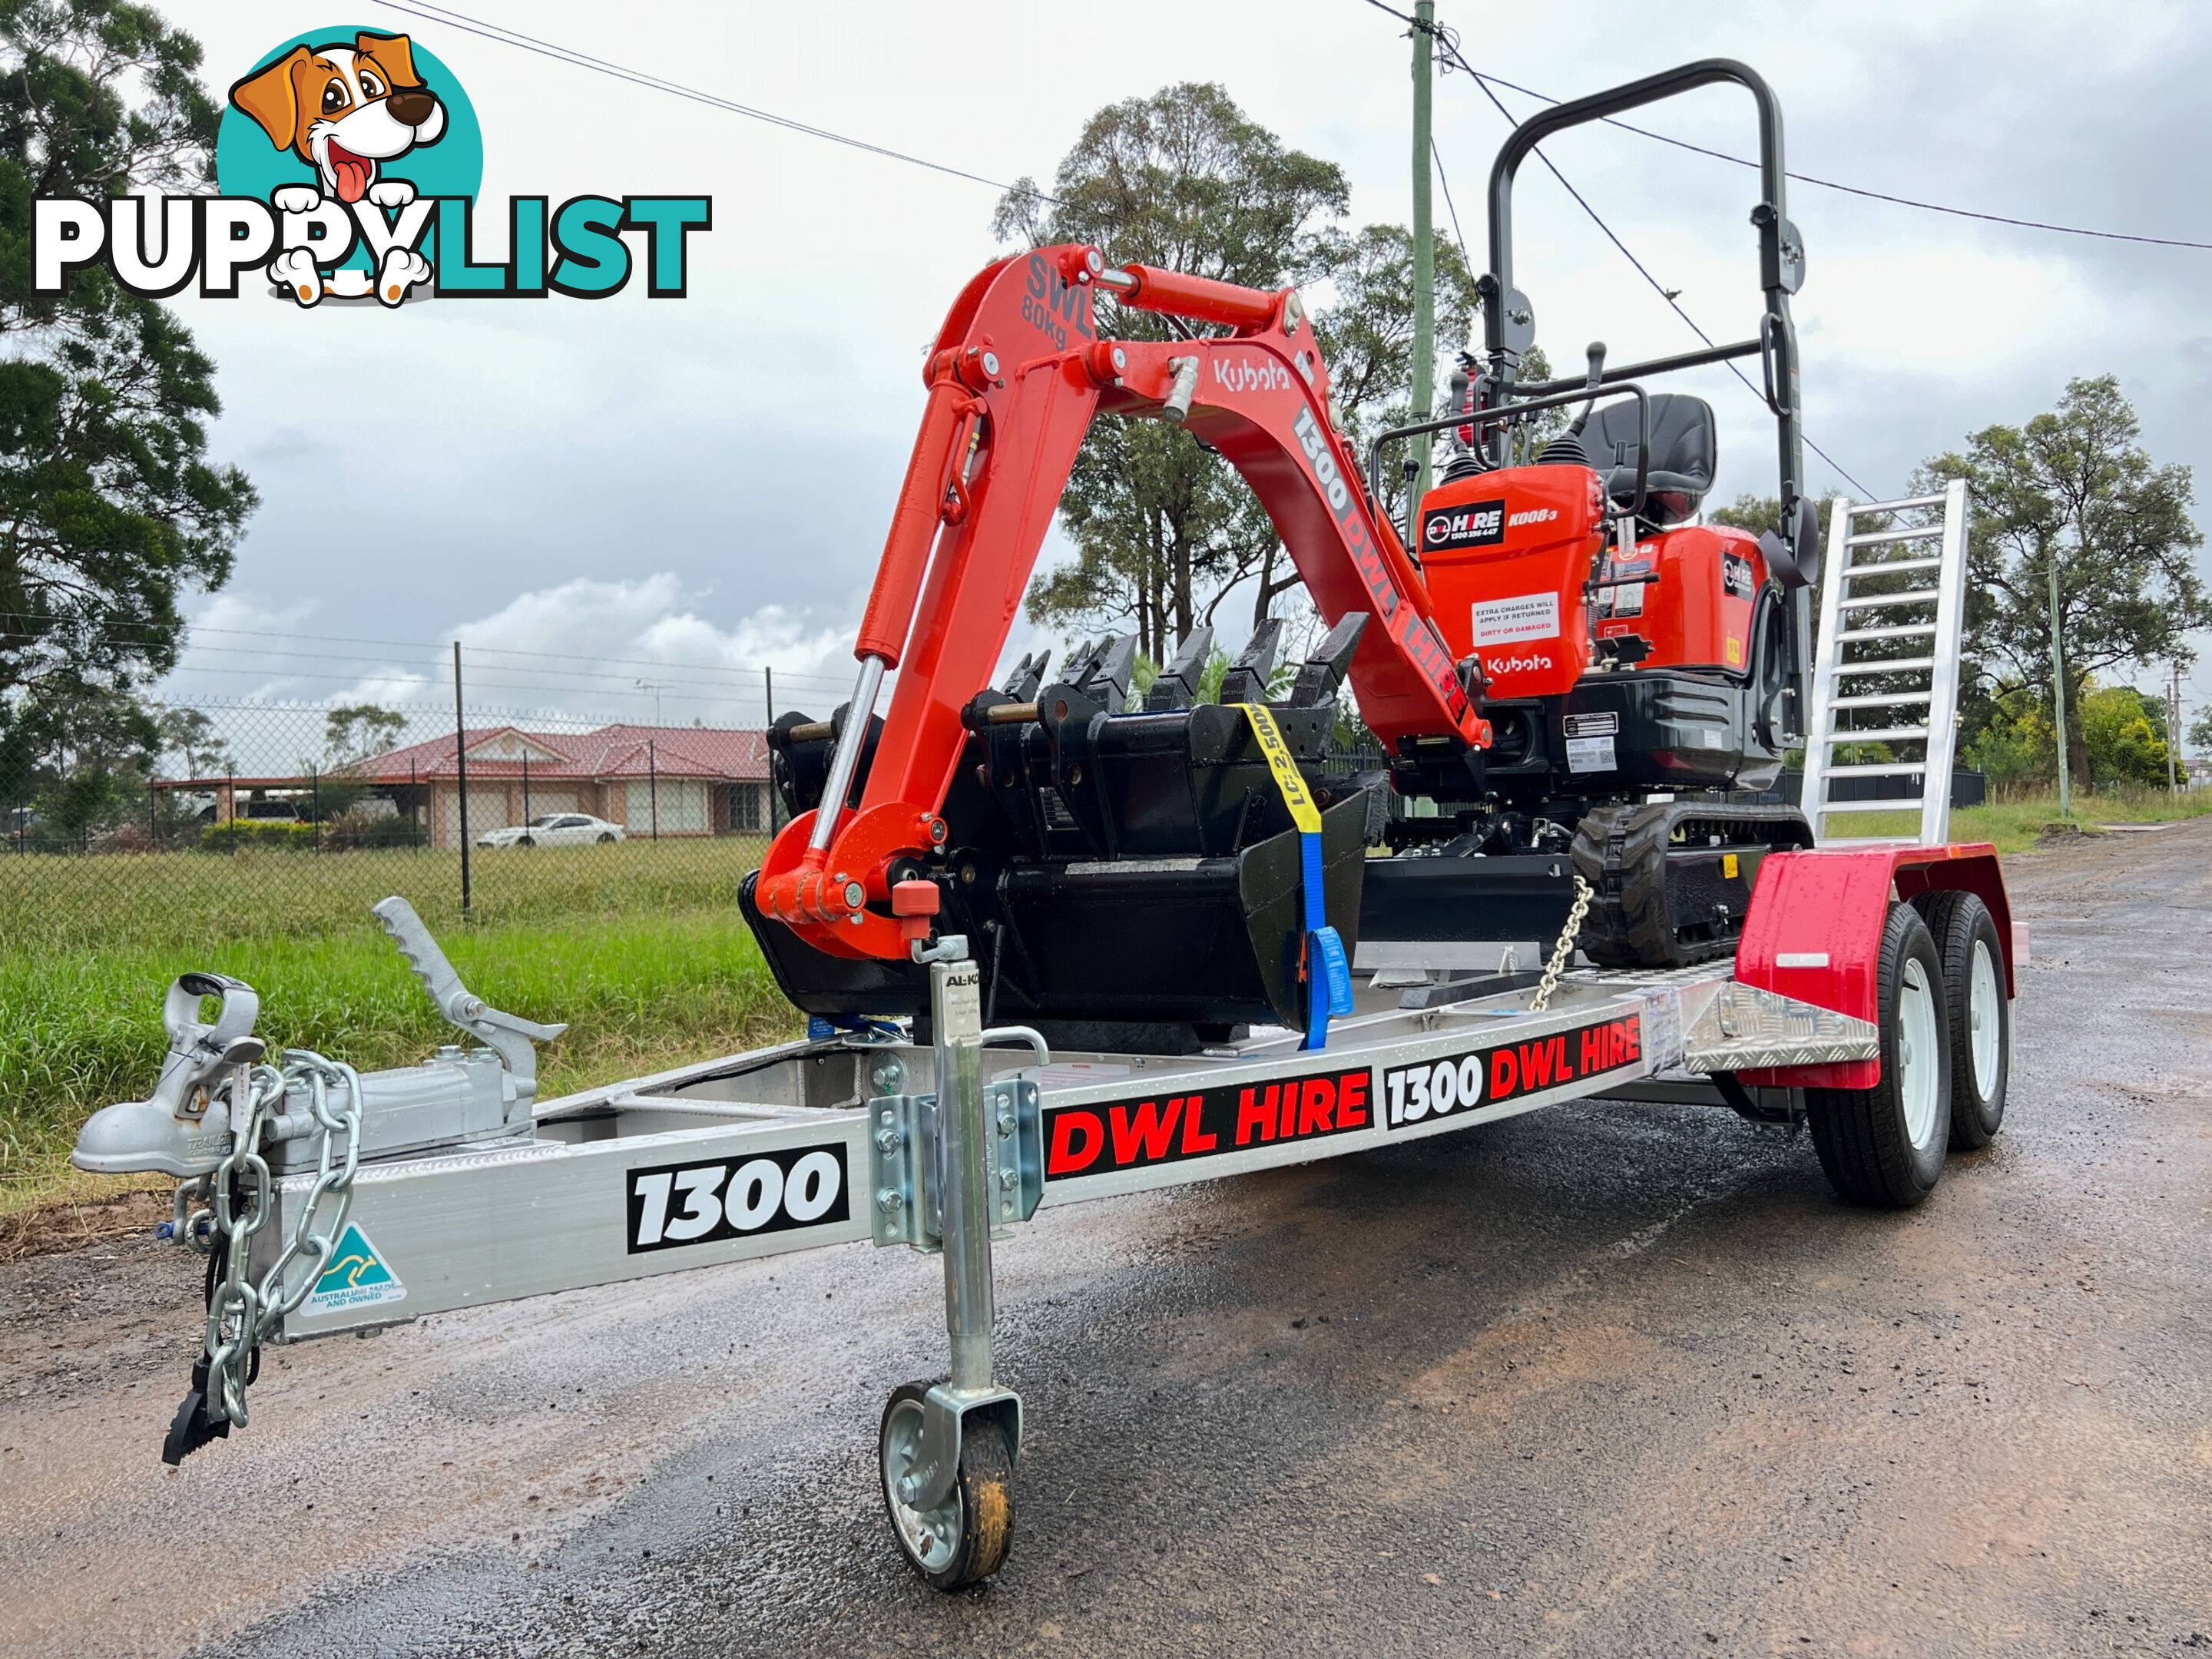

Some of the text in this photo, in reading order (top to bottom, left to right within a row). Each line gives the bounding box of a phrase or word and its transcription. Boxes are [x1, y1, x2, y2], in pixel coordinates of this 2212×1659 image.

[1027, 253, 1092, 340] SWL
[1022, 294, 1067, 352] 80kg
[1214, 359, 1290, 392] Kubota
[1451, 531, 1468, 540] 1300
[1482, 528, 1498, 536] 447
[1452, 510, 1502, 531] HIRE
[1293, 407, 1468, 719] 1300 DWL HIRE
[1501, 603, 1535, 613] CHARGES
[1512, 608, 1551, 619] RETURNED
[1515, 623, 1551, 632] DAMAGED
[1487, 654, 1551, 674] Kubota
[1387, 1017, 1640, 1124] 1300 DWL HIRE
[1048, 1072, 1368, 1174] DWL HIRE
[634, 1151, 840, 1246] 1300
[326, 1298, 346, 1308] AND
[349, 1292, 382, 1304] OWNED
